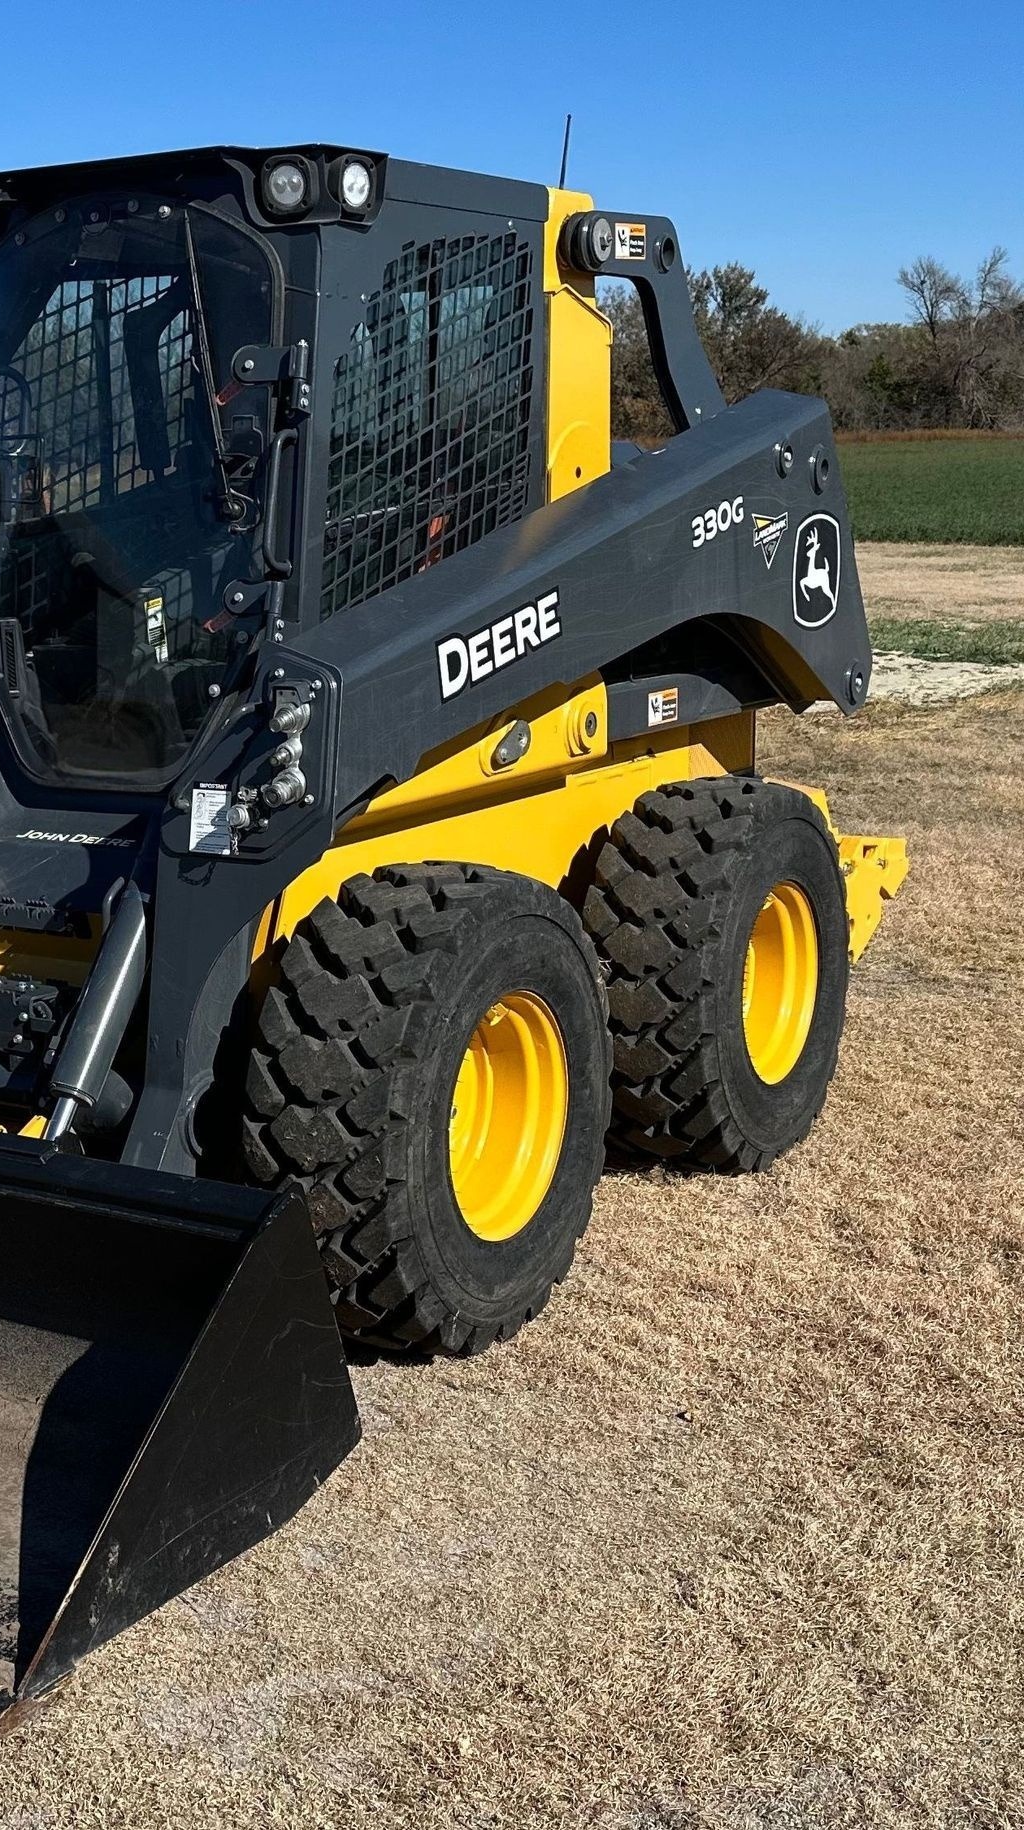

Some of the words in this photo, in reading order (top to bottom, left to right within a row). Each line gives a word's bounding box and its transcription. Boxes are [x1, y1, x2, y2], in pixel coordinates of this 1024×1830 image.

[691, 495, 744, 548] 330G
[437, 591, 560, 700] DEERE
[15, 829, 70, 842] JOHN
[68, 834, 136, 847] DEERE
